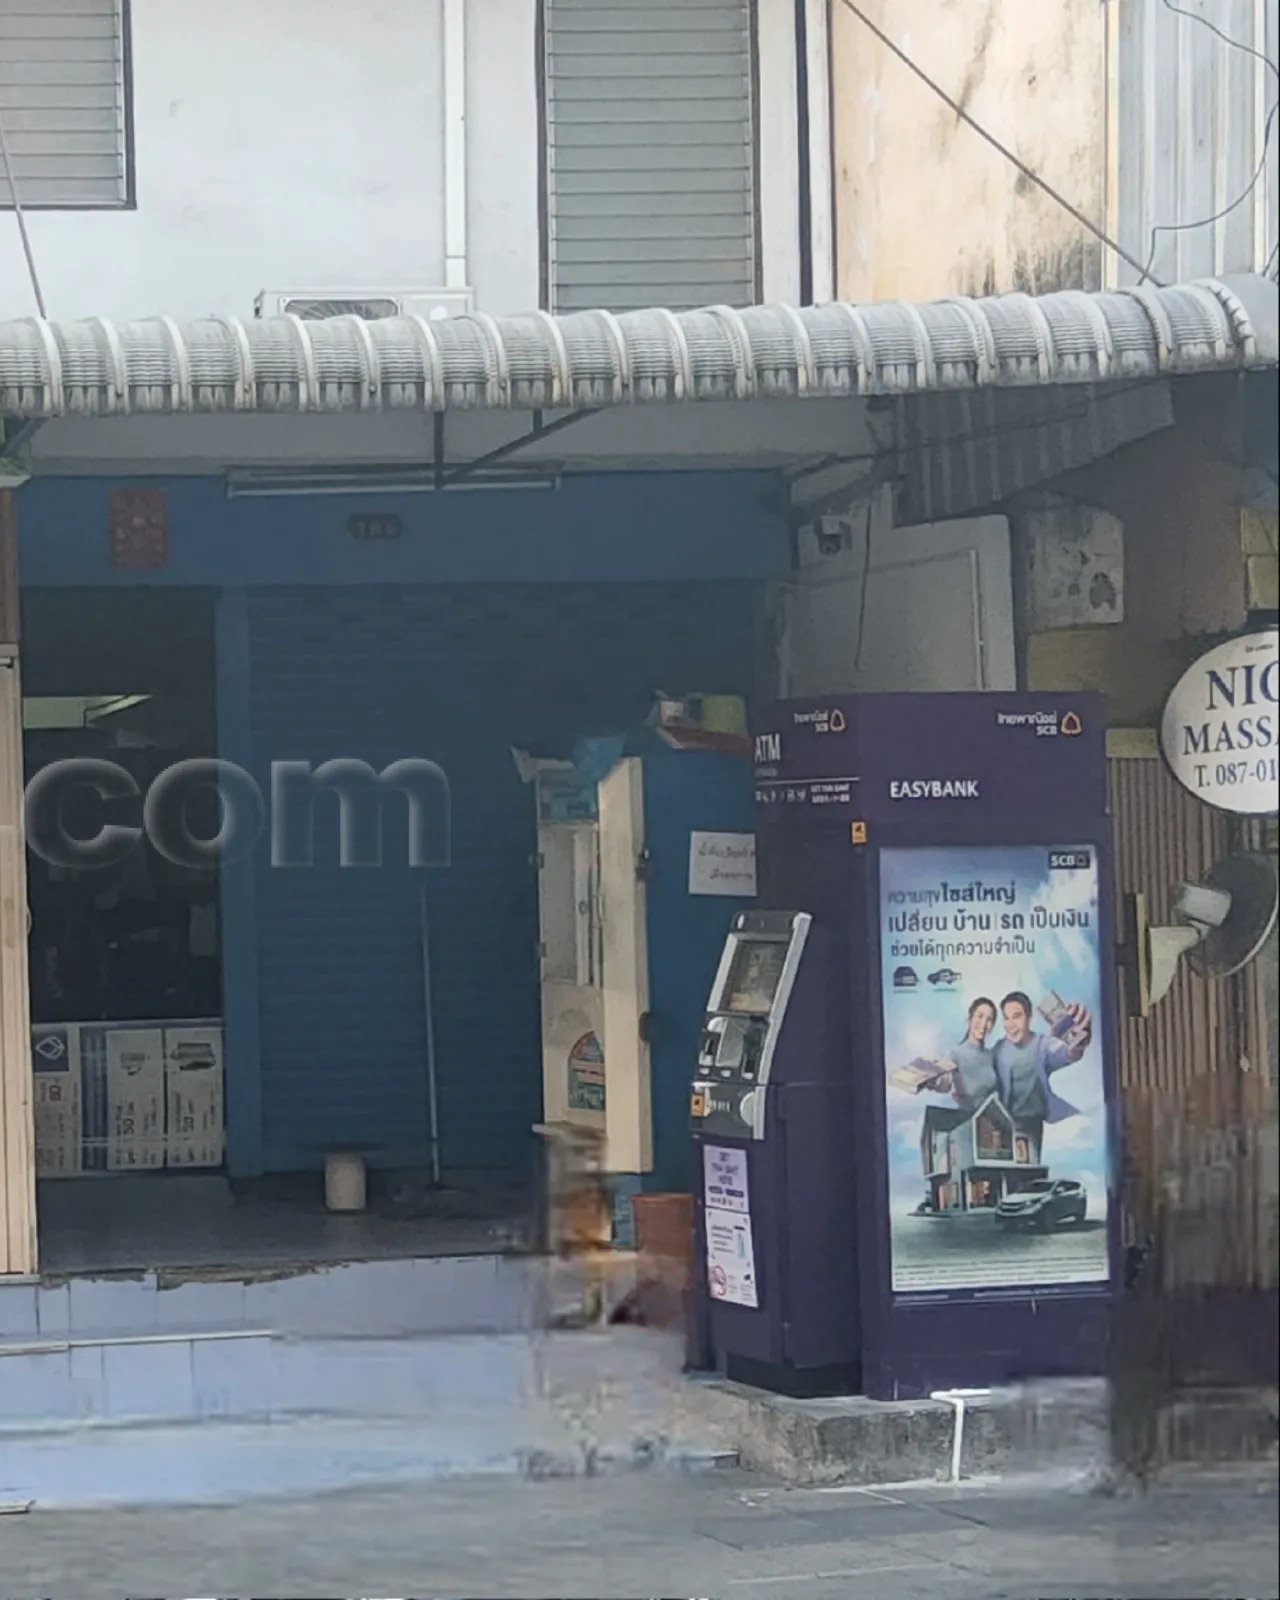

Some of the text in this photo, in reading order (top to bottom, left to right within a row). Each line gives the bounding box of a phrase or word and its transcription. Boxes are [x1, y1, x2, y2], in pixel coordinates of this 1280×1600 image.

[1036, 724, 1058, 736] SCB
[1182, 715, 1279, 756] MASS
[754, 733, 781, 763] ATM
[1194, 764, 1211, 788] T.
[890, 780, 979, 798] EASYBANK
[888, 908, 948, 933] เปลี่ยน
[953, 908, 991, 930] บ้าน
[1001, 912, 1025, 929] รถ
